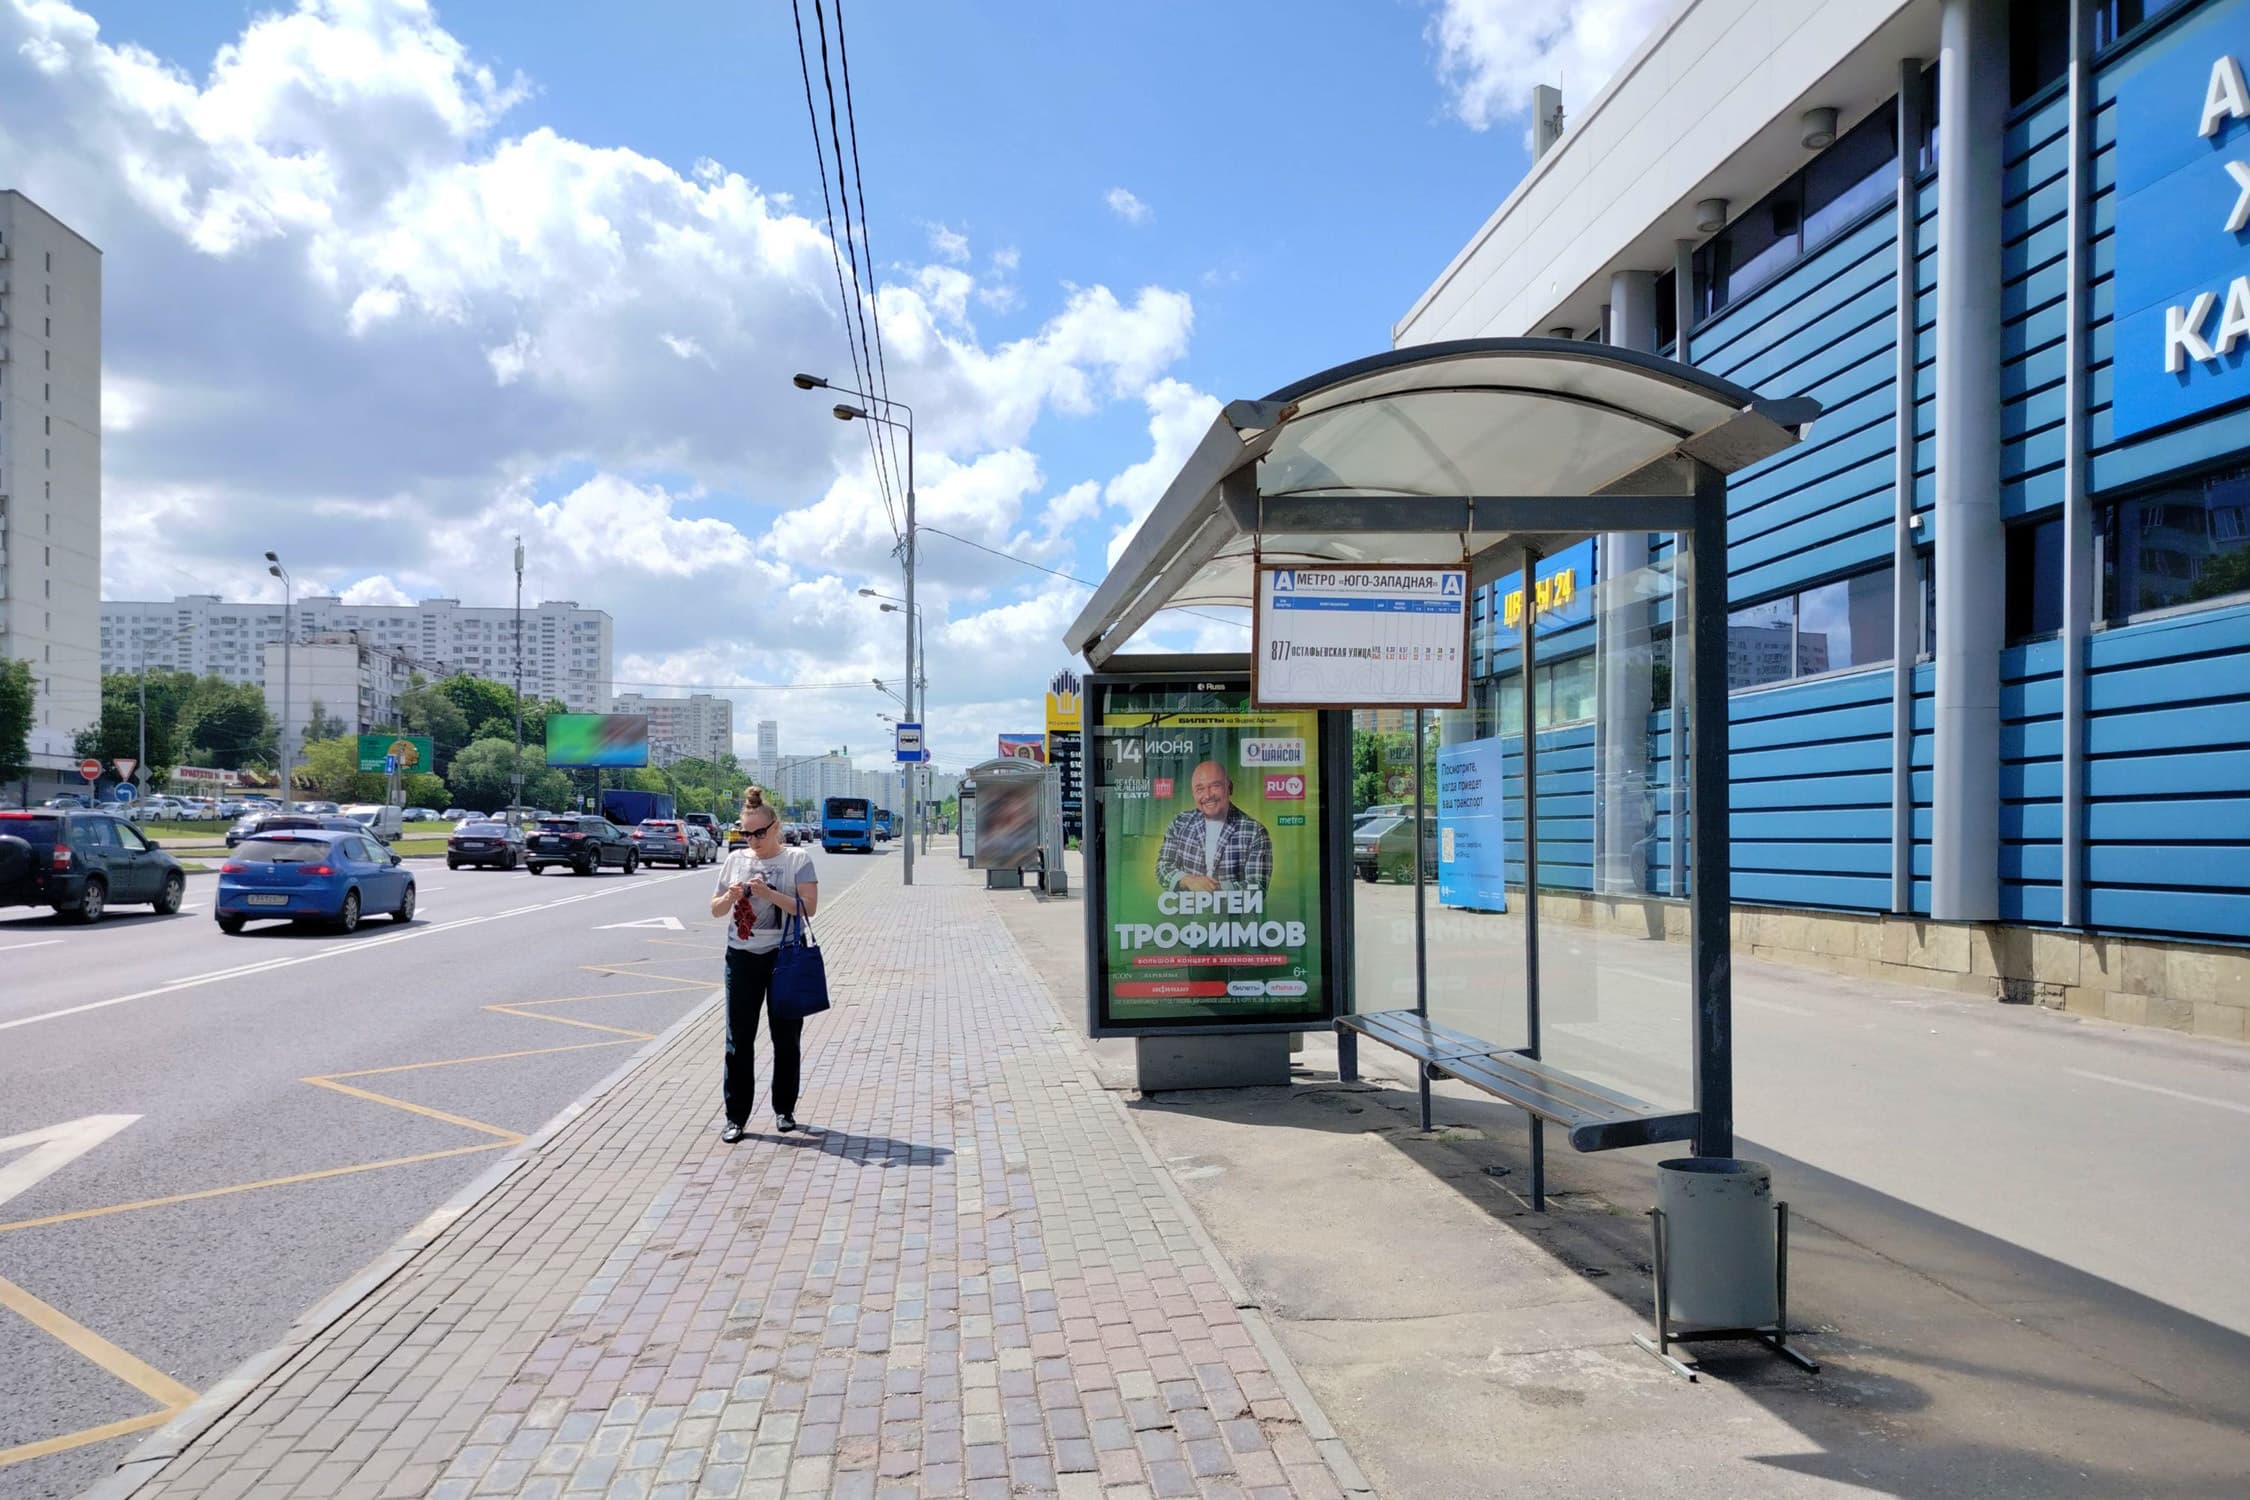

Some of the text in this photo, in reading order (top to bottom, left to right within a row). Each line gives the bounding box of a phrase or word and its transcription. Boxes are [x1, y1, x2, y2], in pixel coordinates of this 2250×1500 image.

[1297, 573, 1336, 586] МЕТРО
[1554, 567, 1576, 607] 24
[1271, 640, 1291, 661] 877
[1291, 646, 1347, 658] ОСТАФЬЕВСКАЯ
[1349, 647, 1372, 660] УЛИЦА
[1206, 683, 1226, 691] Russ
[1112, 738, 1194, 764] 14 ИЮНЯ
[1261, 748, 1301, 762] ШАНСОН
[1441, 762, 1478, 776] Посмотрите,
[1441, 779, 1482, 793] когда приедет
[1442, 796, 1484, 810] ваш транспорт
[1279, 817, 1304, 825] metro
[1157, 883, 1263, 916] СЕРГЕЙ
[1115, 920, 1306, 950] ТРОФИМОВ
[1293, 966, 1307, 977] 6+
